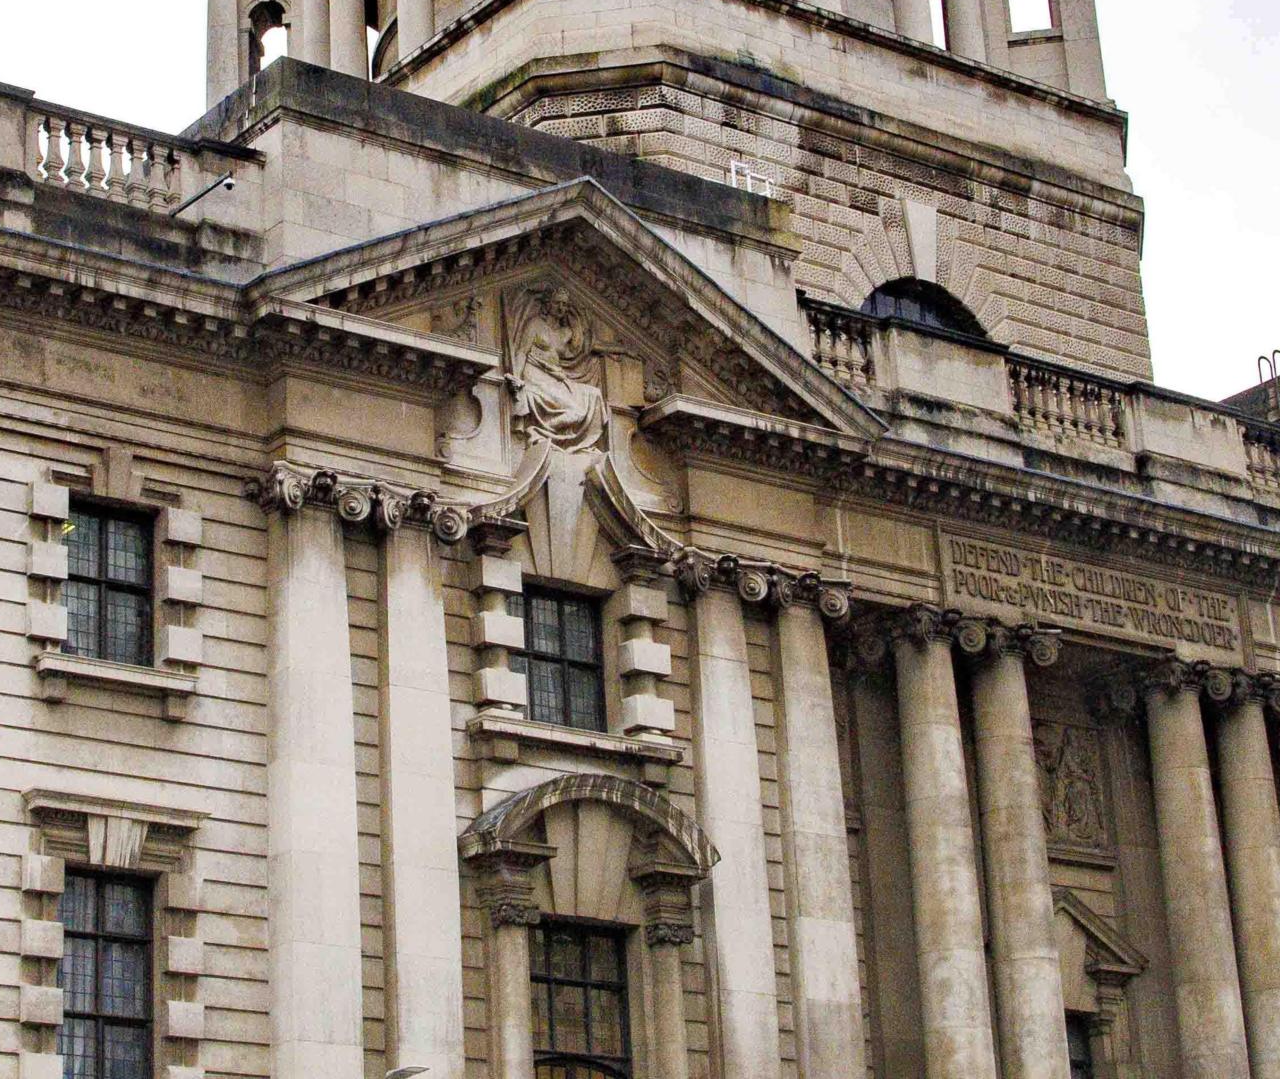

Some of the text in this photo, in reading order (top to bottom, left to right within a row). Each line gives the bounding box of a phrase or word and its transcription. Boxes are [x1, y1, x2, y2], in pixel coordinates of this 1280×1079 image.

[950, 539, 1230, 622] DEFEND THE CHILDREN OF THE
[953, 568, 1003, 602] POOR
[1086, 597, 1124, 628] THE
[1127, 605, 1236, 651] WRONGDOER
